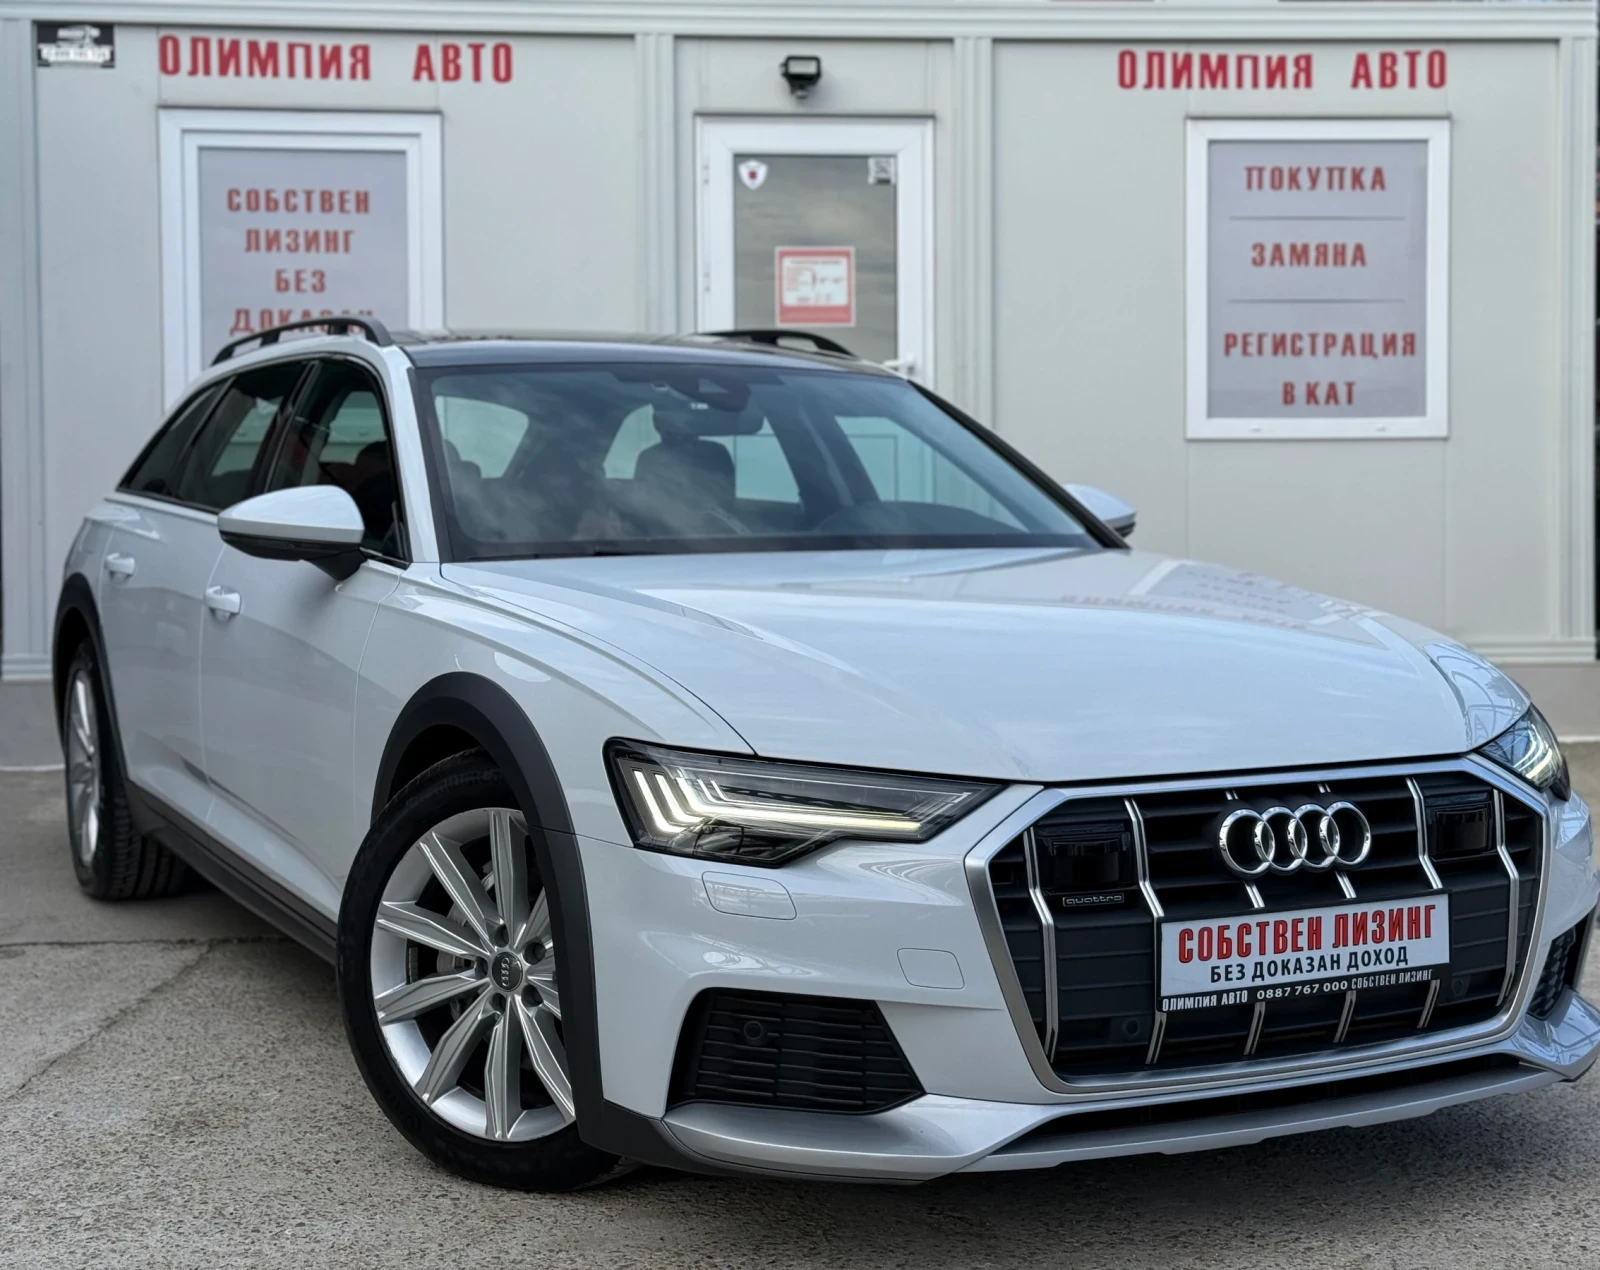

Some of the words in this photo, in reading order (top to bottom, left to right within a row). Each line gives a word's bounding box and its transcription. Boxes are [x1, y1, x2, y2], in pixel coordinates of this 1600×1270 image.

[159, 35, 371, 81] ОЛИМПИЯ
[412, 42, 513, 84] АВТО
[1117, 49, 1313, 89] ОЛИМПИЯ
[1351, 49, 1448, 89] АВТО
[1244, 165, 1386, 191] ПОКУПКА
[226, 188, 370, 214] СОБСТВЕН
[244, 229, 353, 254] ЛИЗИНГ
[1251, 242, 1367, 267] ЗАМЯНА
[275, 269, 326, 294] БЕЗ
[1224, 332, 1417, 359] РЕГИСТРАЦИЯ
[1281, 381, 1296, 406] В
[1304, 381, 1357, 406] КАТ
[1066, 895, 1122, 905] quattro
[1178, 916, 1322, 964] СОБСТВЕН
[1332, 904, 1436, 949] ЛИЗИНГ
[1210, 963, 1246, 984] БЕЗ
[1251, 953, 1341, 983] ДОКАЗАН
[1347, 946, 1408, 972] ДОХОД
[1162, 994, 1218, 1012] ОЛИМПИЯ
[1221, 989, 1248, 1006] АВТО
[1256, 987, 1291, 1000] 0887
[1294, 983, 1320, 996] 767
[1322, 980, 1348, 993] 000
[1351, 973, 1396, 990] СОБСТВЕН
[1398, 968, 1433, 985] ЛИЗИНГ
